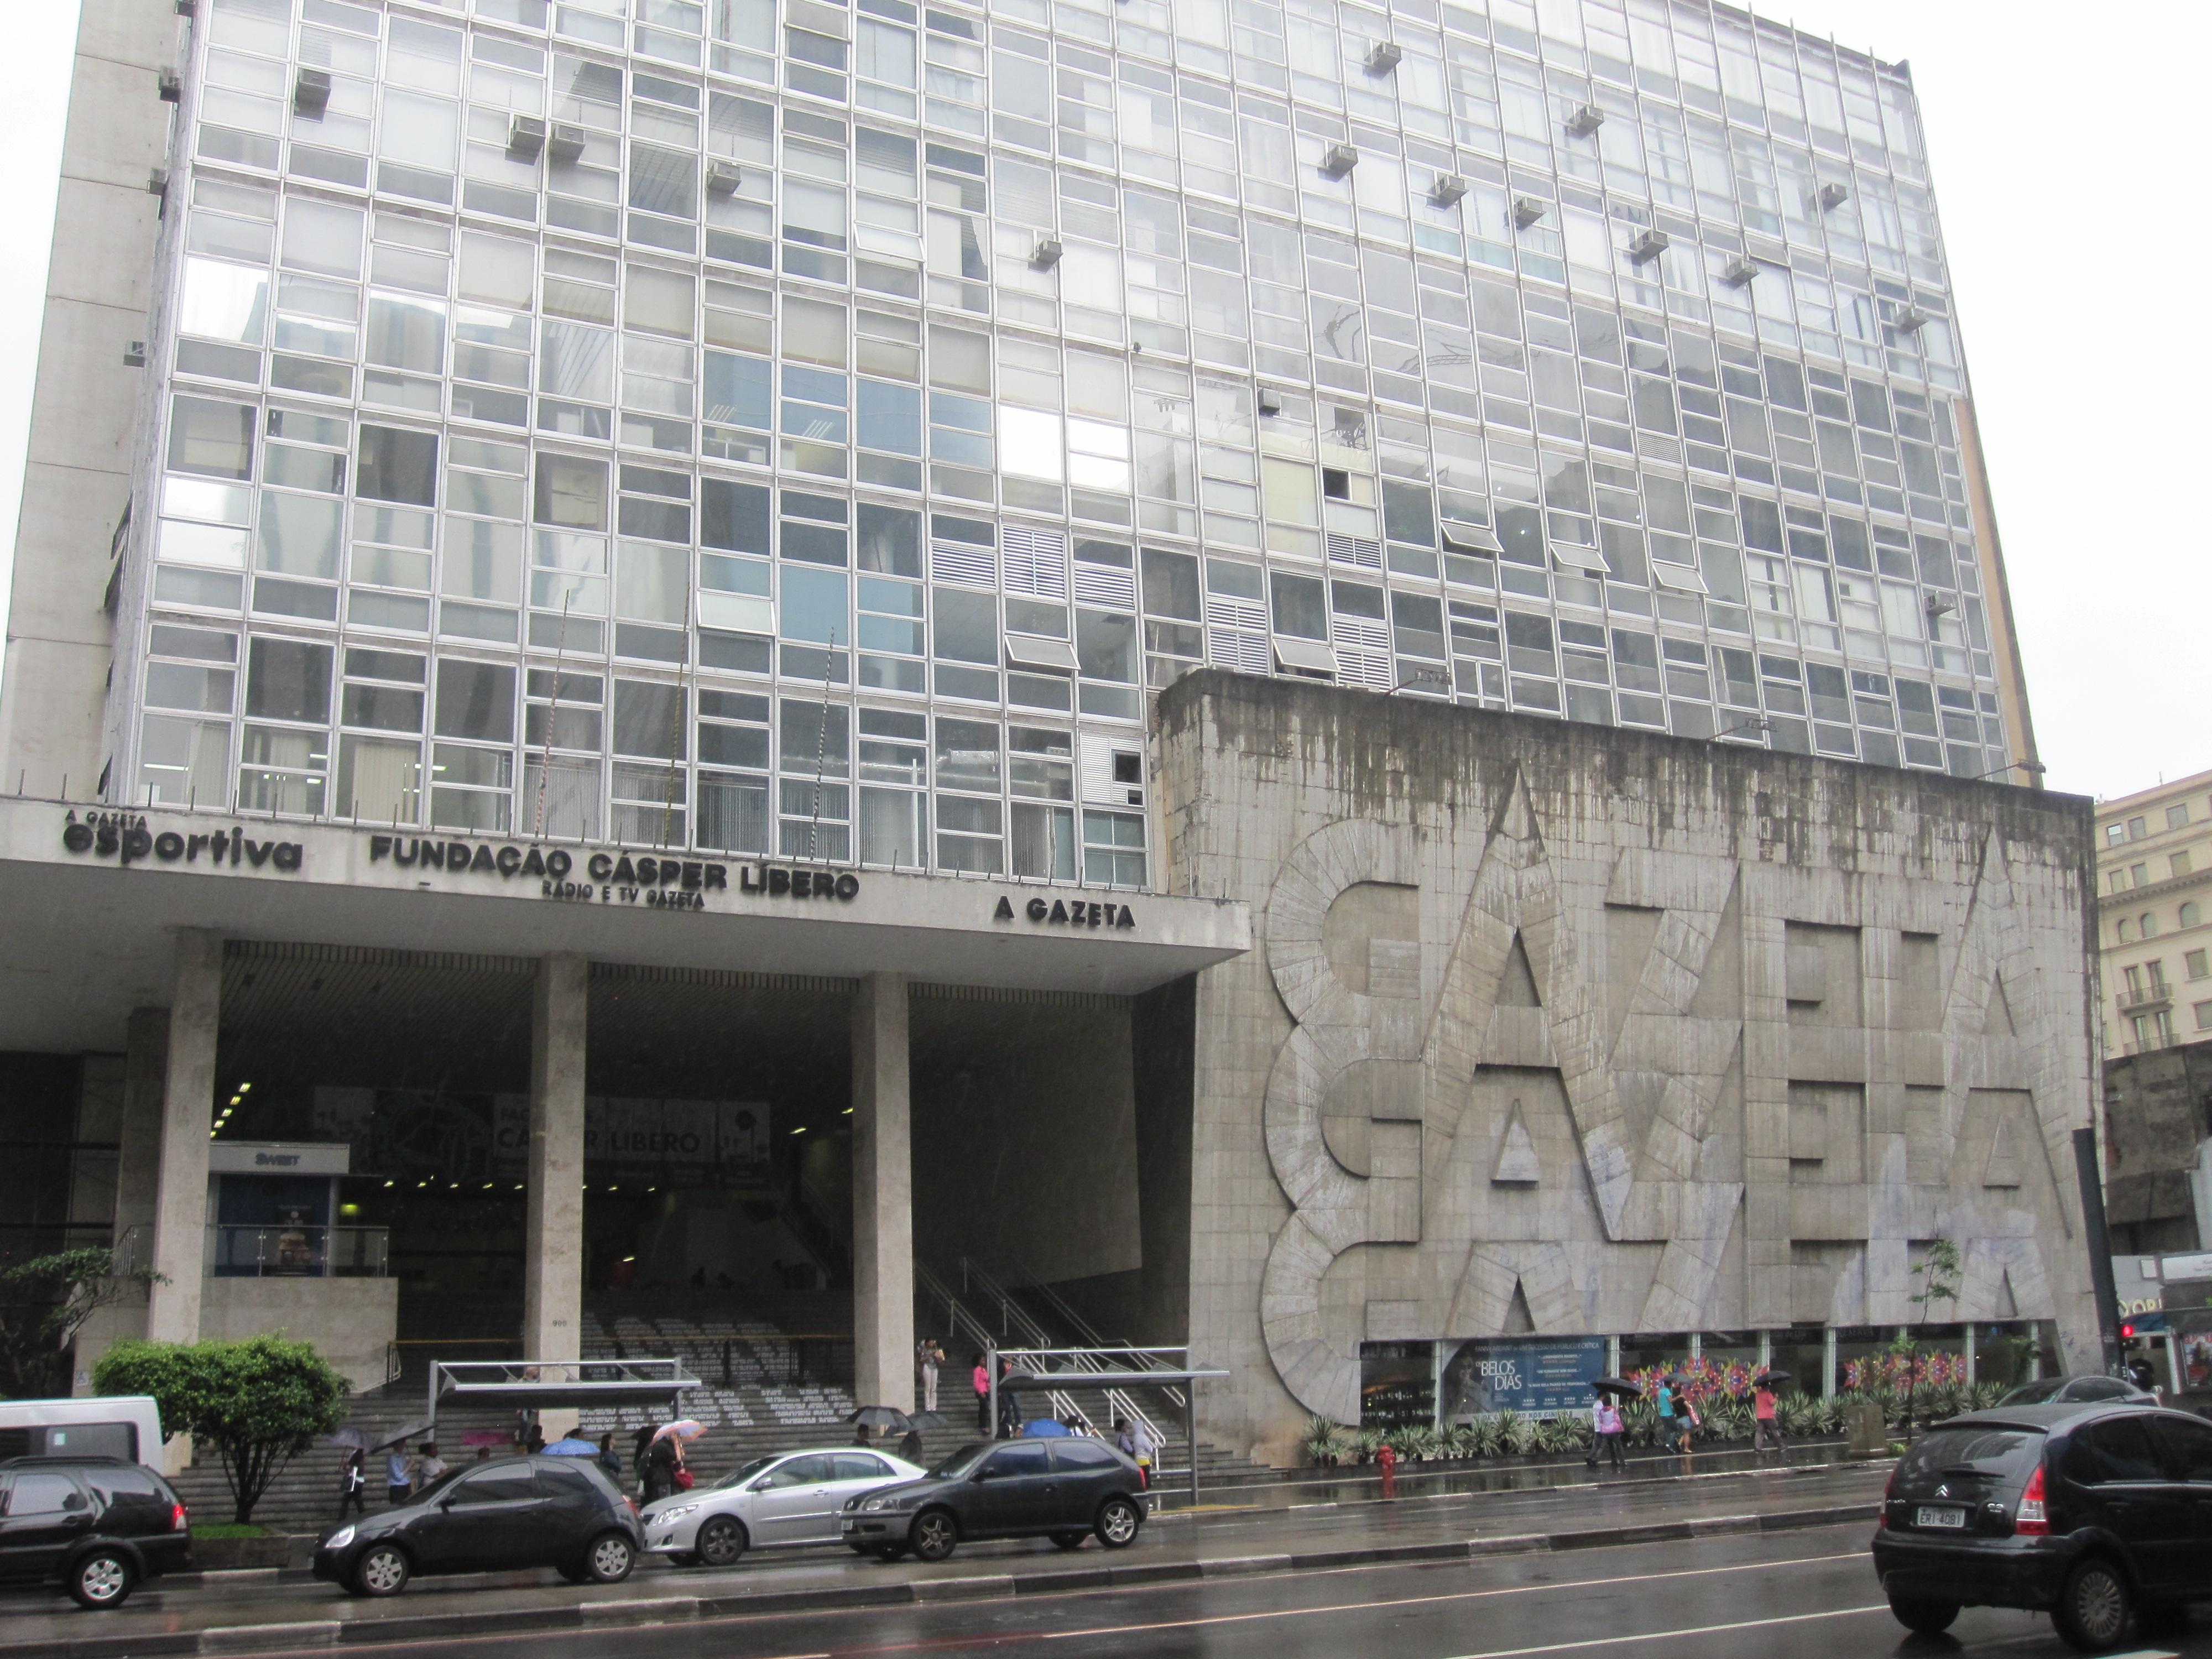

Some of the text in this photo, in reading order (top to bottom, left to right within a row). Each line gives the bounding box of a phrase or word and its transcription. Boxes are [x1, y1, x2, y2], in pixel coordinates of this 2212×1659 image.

[65, 810, 76, 822] A
[62, 824, 303, 869] esportiva
[371, 835, 860, 901] FUNDAÇÃO CÁSPER LÍBERO
[542, 879, 705, 908] RÁDIO E TV GAZETA
[994, 895, 1136, 928] A GAZETA
[1481, 1360, 1515, 1376] BELOS
[1495, 1375, 1521, 1390] DIAS
